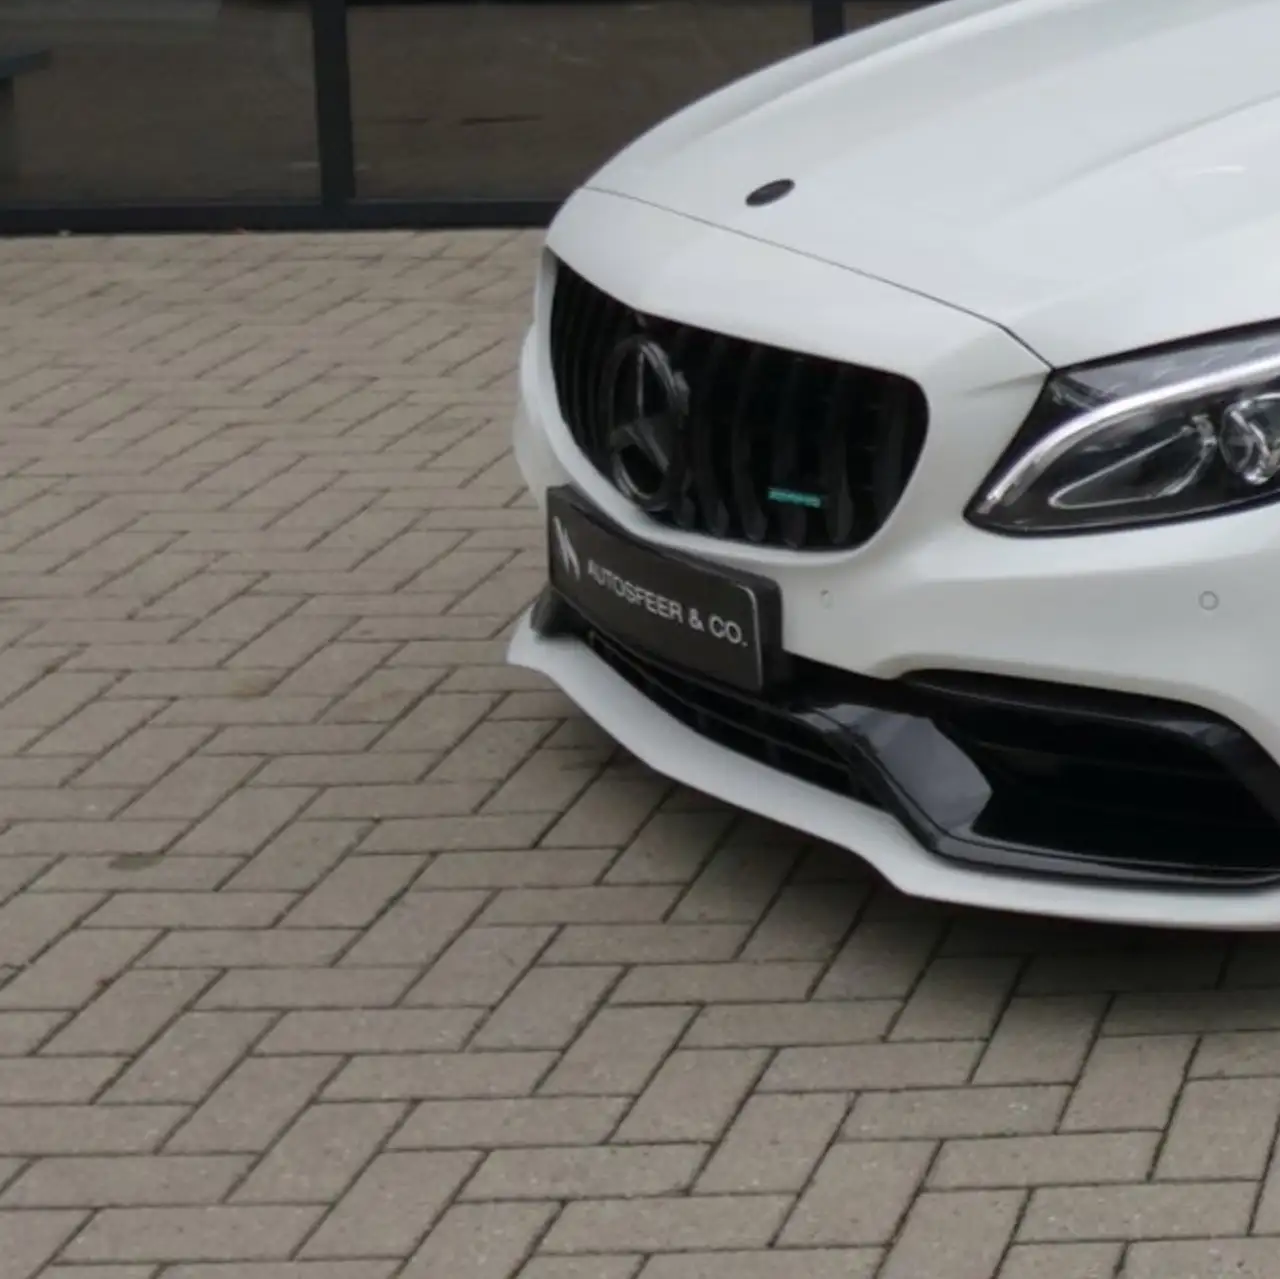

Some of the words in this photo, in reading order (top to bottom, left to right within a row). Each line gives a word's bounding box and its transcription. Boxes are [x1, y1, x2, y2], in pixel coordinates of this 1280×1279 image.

[587, 559, 683, 623] AUTOSFEER
[687, 607, 705, 632] &
[709, 613, 749, 647] CO.
